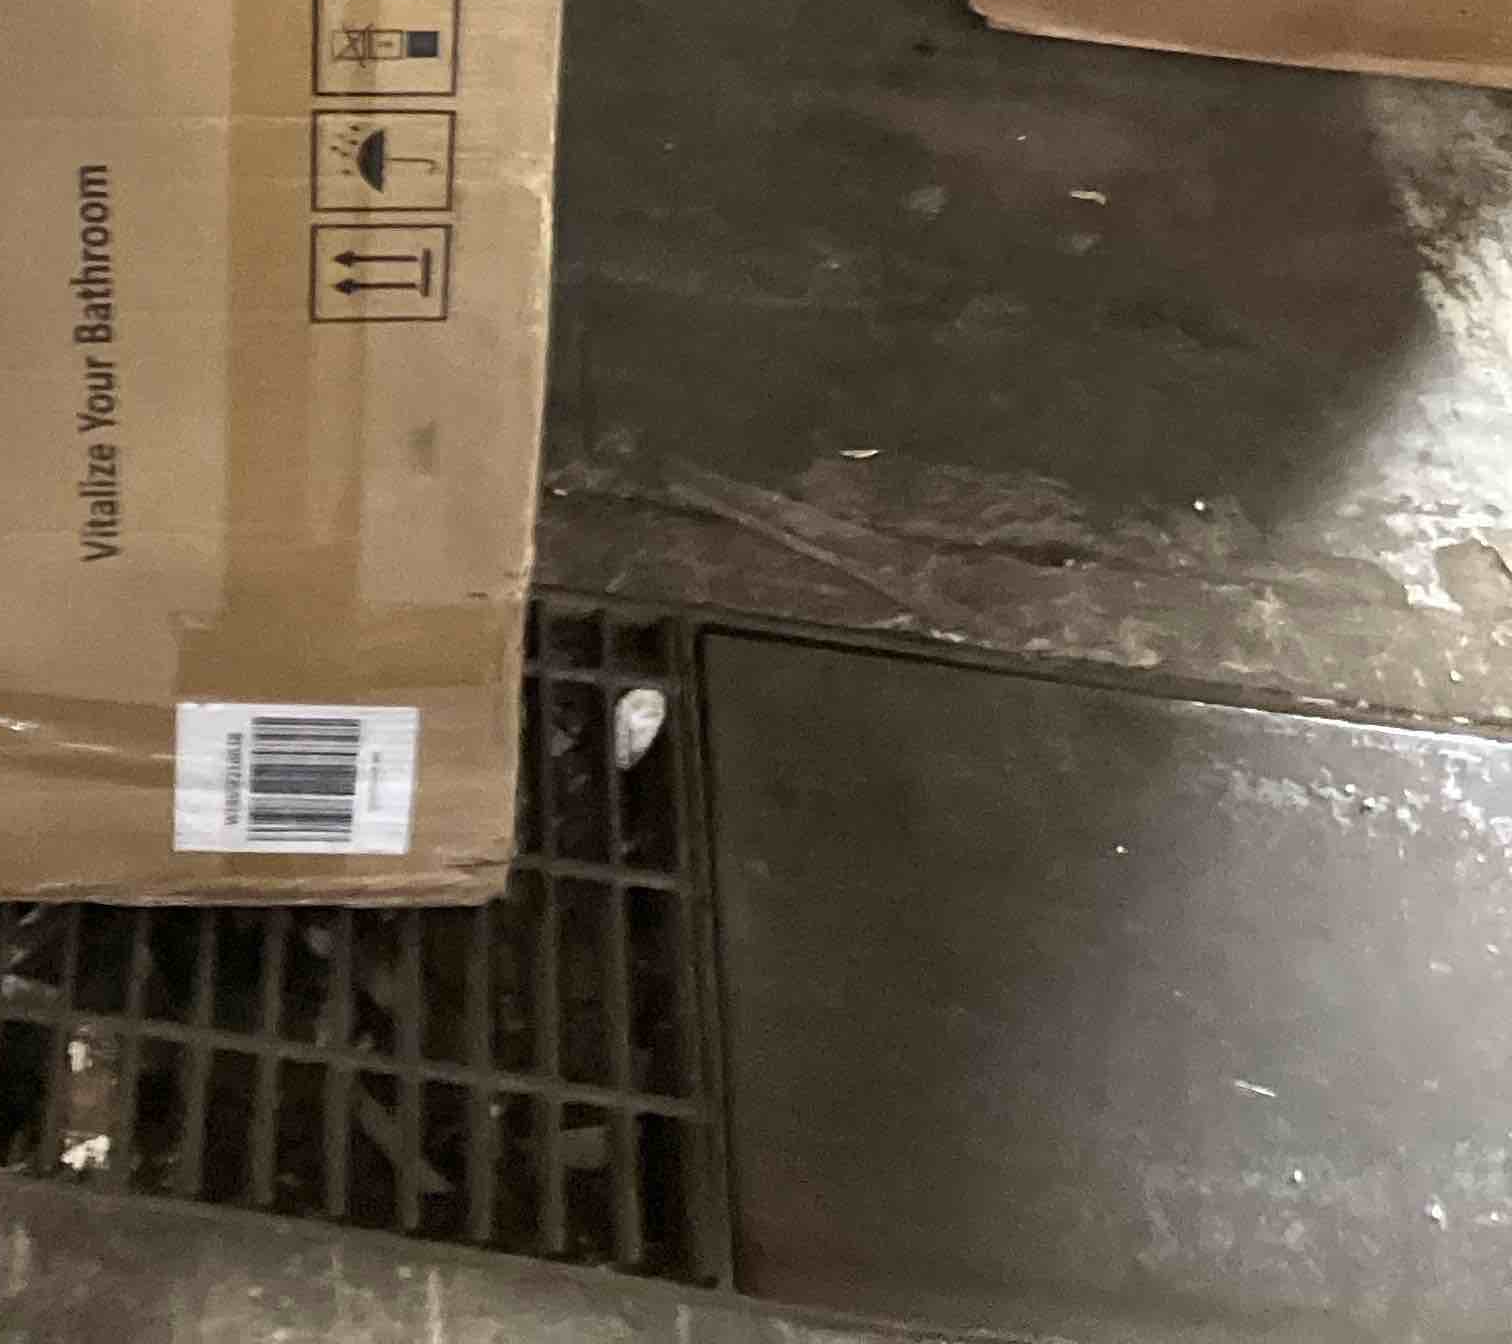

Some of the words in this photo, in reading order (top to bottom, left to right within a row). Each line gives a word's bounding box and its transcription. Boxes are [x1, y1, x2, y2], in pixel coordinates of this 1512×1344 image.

[69, 164, 115, 345] Bathroom
[75, 354, 120, 434] Your
[78, 441, 122, 563] Vitalize
